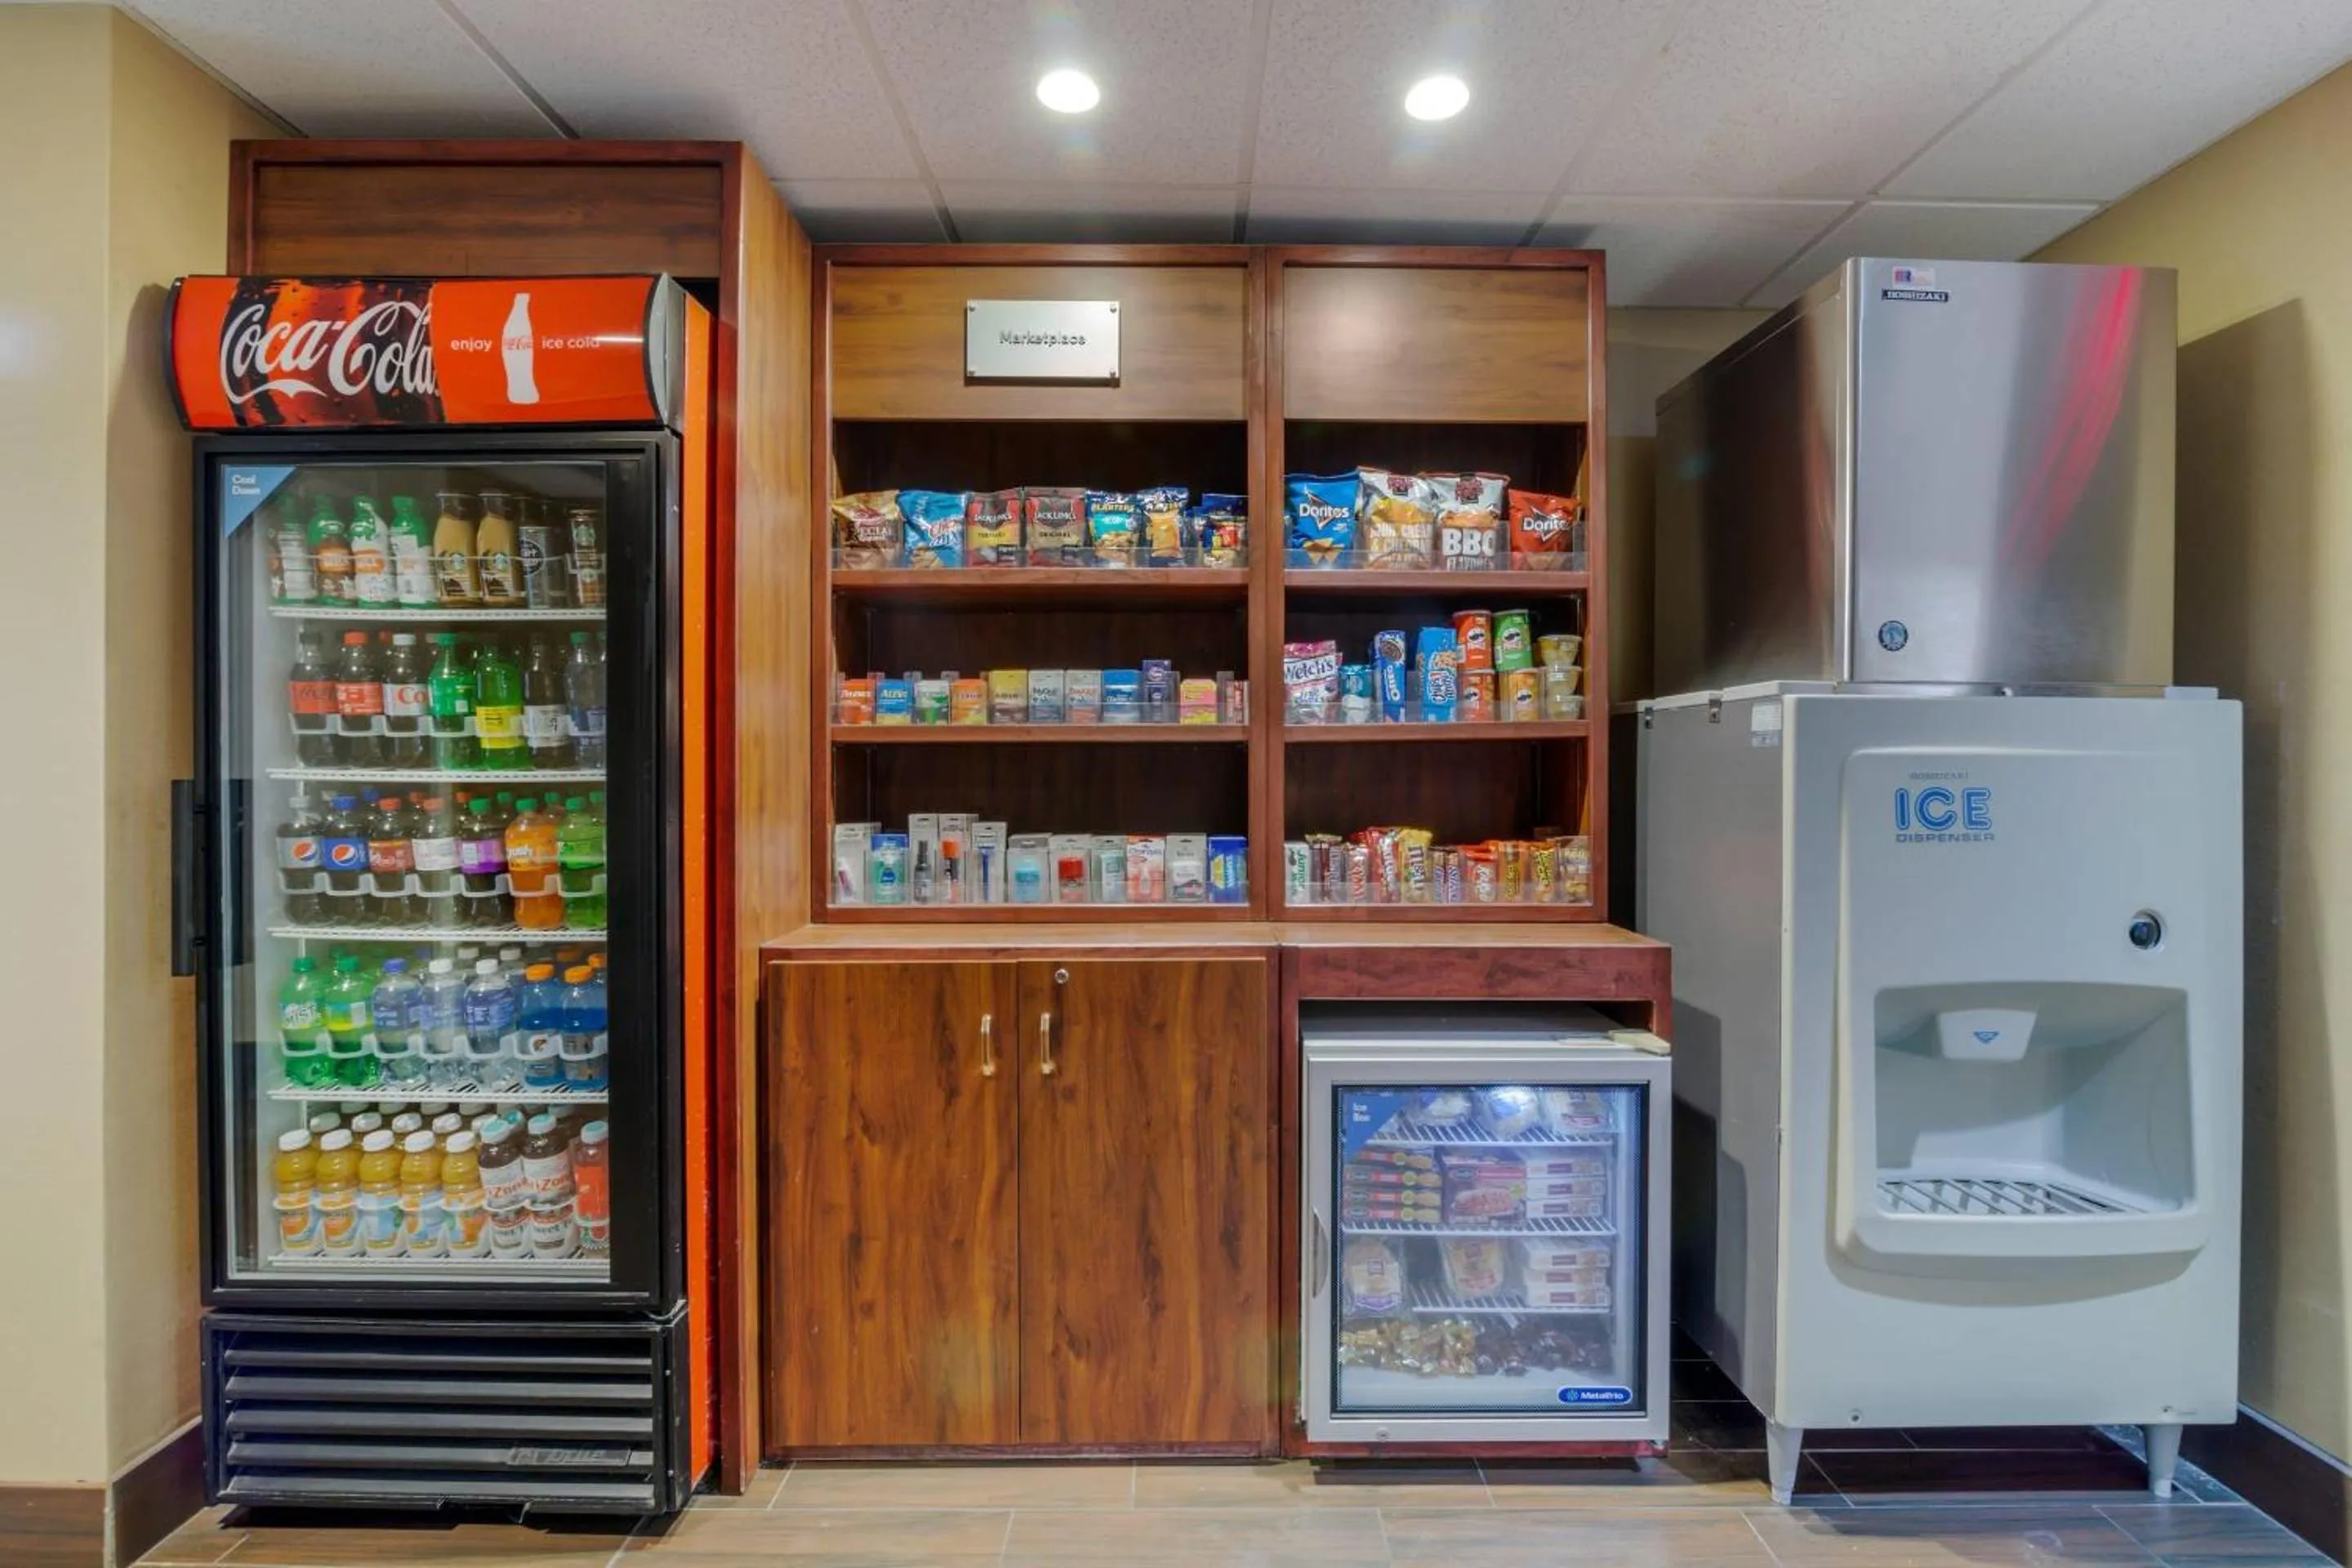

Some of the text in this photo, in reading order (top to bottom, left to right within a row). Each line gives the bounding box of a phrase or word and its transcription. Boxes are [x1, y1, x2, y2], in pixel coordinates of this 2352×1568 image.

[450, 337, 492, 352] enjoy
[541, 336, 564, 349] ice
[567, 336, 601, 349] cold
[999, 331, 1087, 347] Marketplace
[220, 301, 436, 403] Coca-Cola
[1298, 502, 1349, 519] Doritos
[1285, 657, 1334, 680] Welch's
[1895, 786, 1993, 831] ICE
[1895, 833, 1996, 843] DISPENSER
[1296, 849, 1307, 890] Junior
